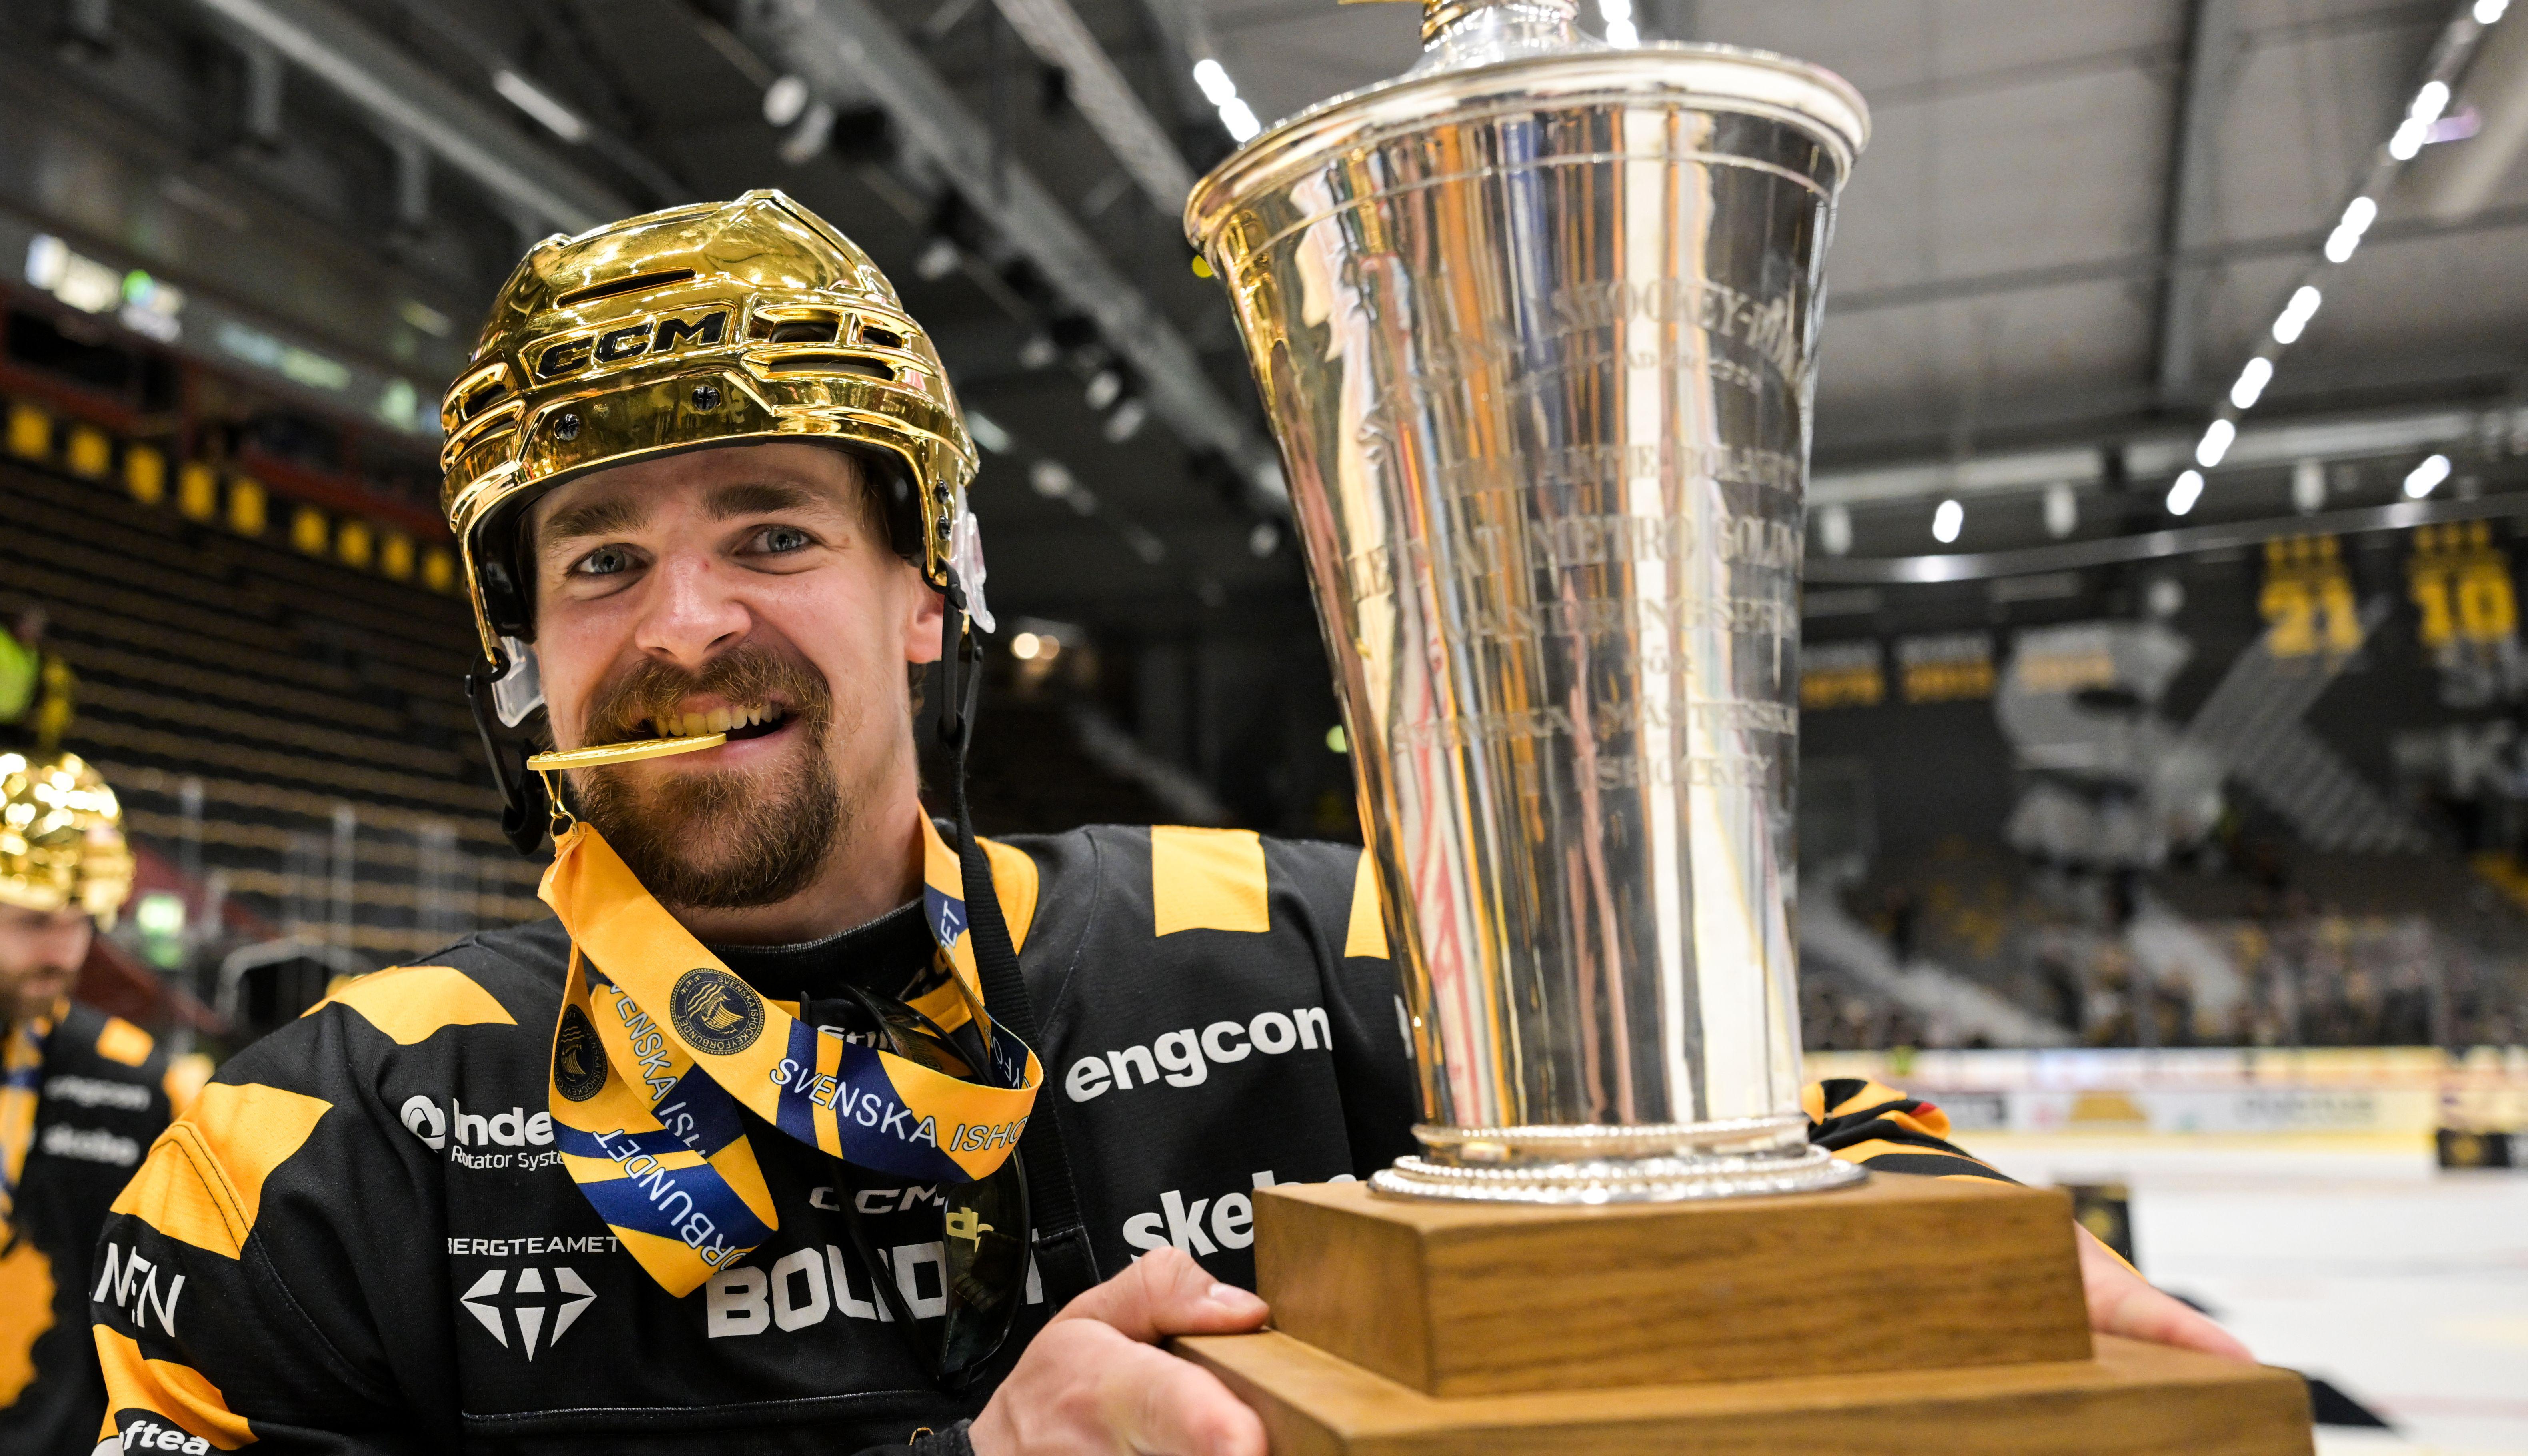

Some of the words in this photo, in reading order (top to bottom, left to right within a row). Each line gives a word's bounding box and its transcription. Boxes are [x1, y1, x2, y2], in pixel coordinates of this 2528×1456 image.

[536, 310, 729, 378] CCM
[2259, 577, 2363, 658] 21
[2408, 567, 2516, 647] 10
[717, 975, 756, 1008] SVENSKA
[677, 1009, 759, 1051] ISHOCKEYFÖRBUNDET
[1065, 1007, 1332, 1102] engcon
[770, 1058, 937, 1148] SVENSKA
[451, 1145, 513, 1169] Rotator
[809, 1184, 945, 1214] CCM
